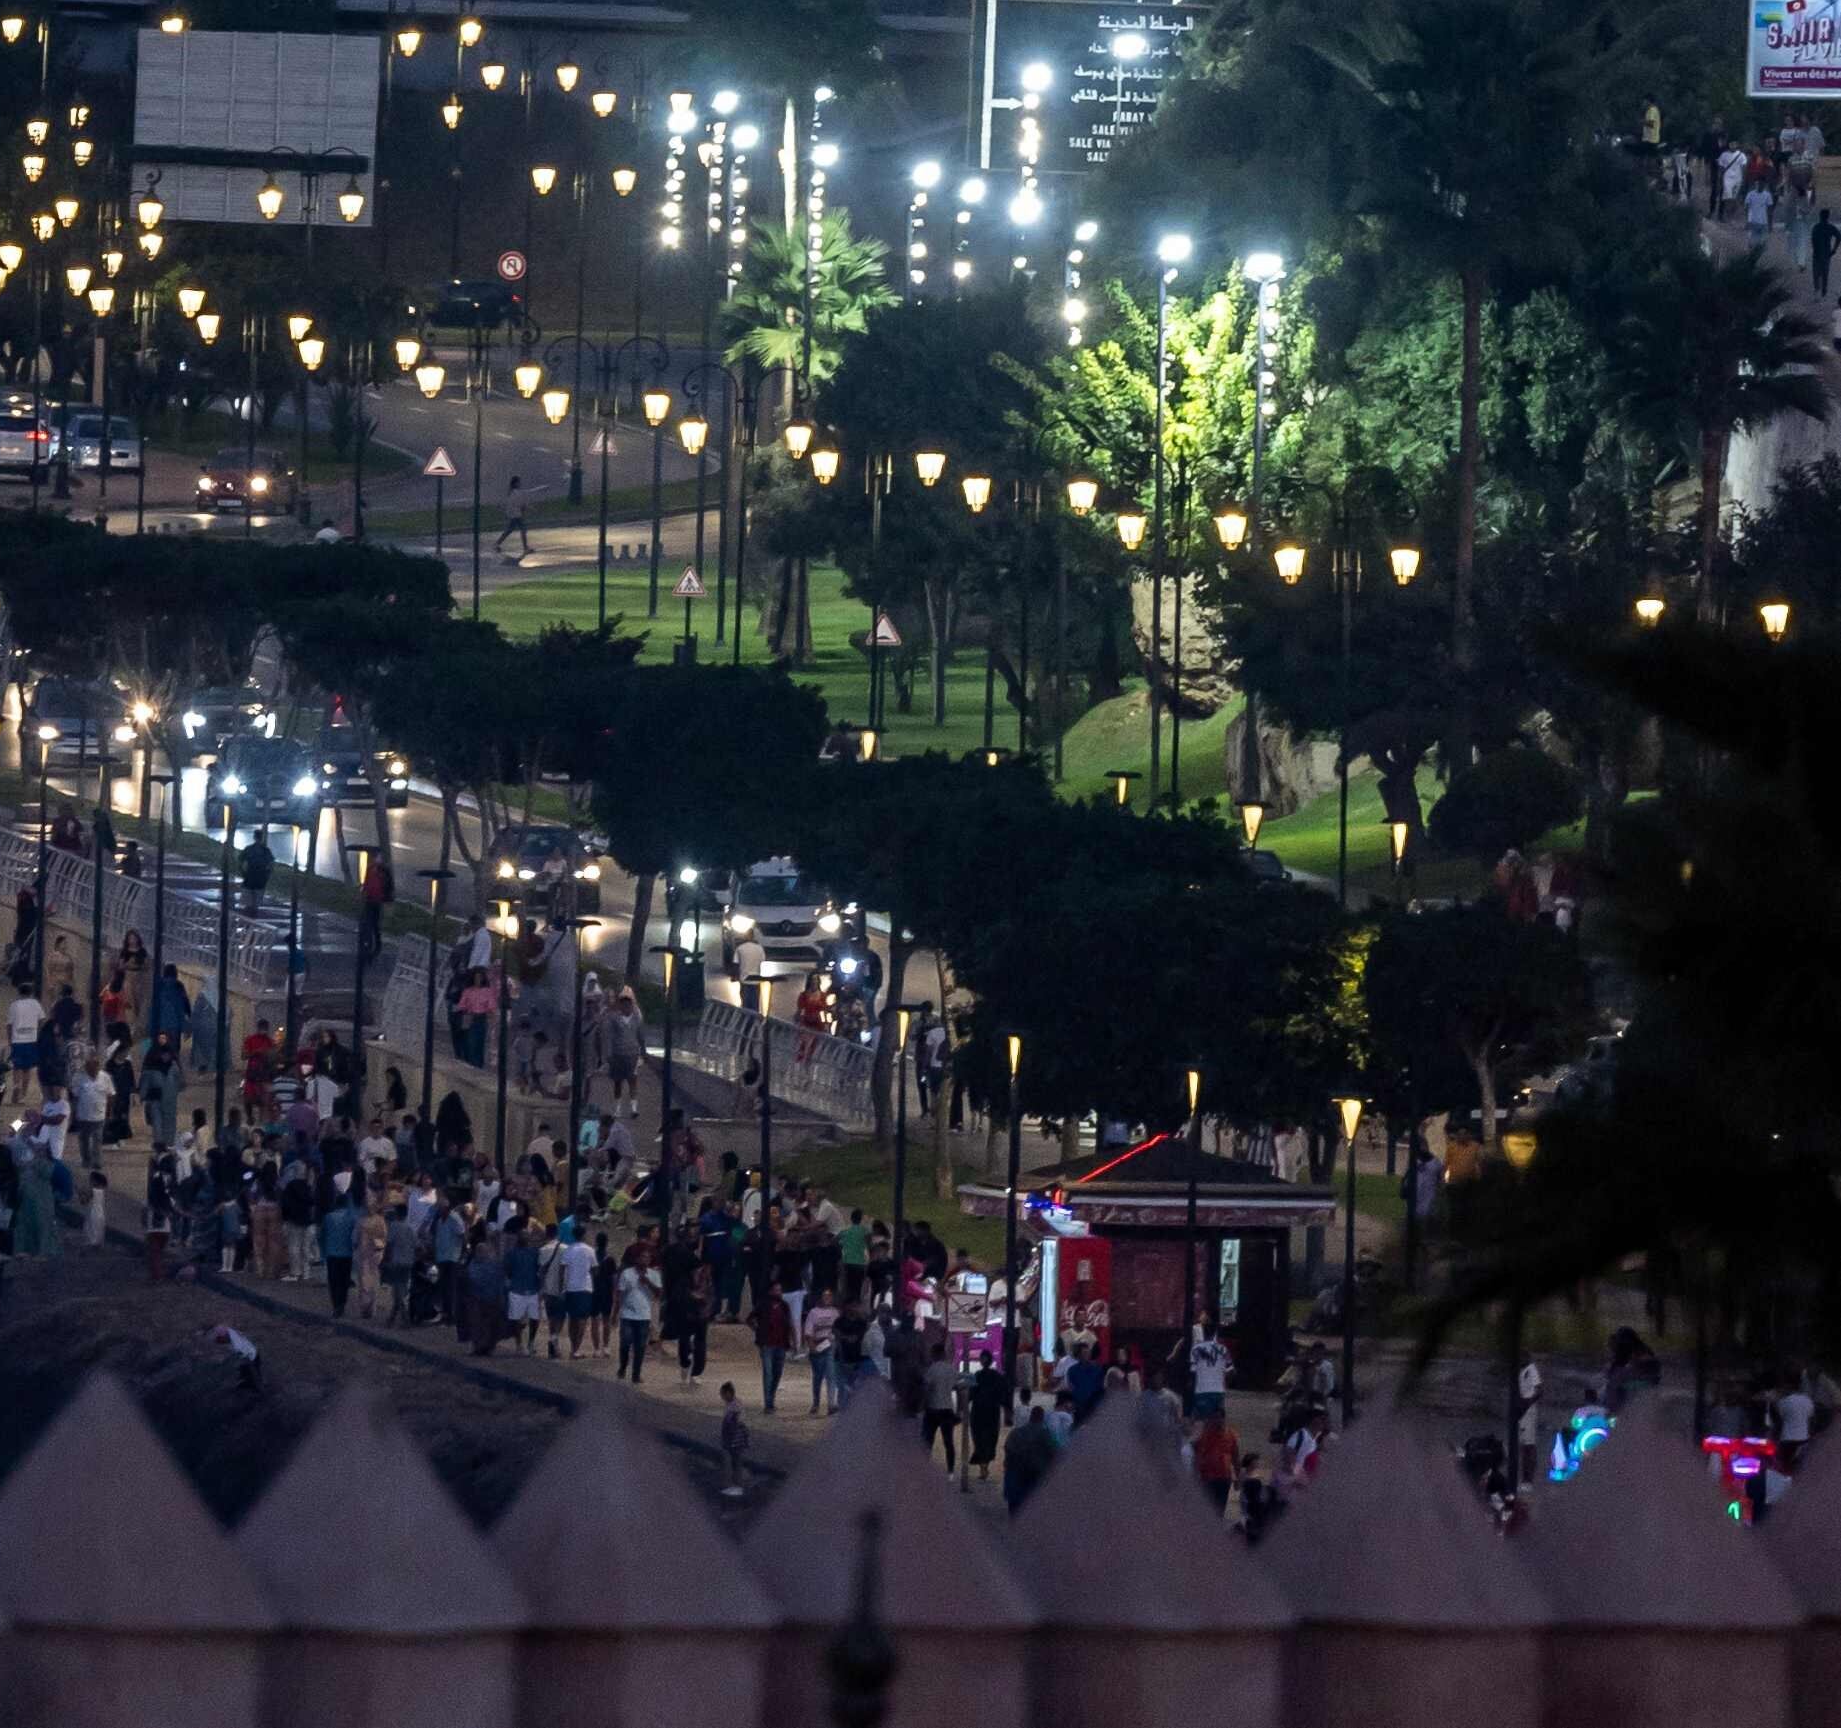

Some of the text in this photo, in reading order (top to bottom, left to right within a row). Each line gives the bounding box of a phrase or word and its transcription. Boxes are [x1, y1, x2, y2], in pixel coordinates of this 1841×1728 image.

[1098, 15, 1194, 36] الرباط المدينة
[1764, 69, 1793, 79] Vivez
[1793, 70, 1808, 79] un
[1091, 123, 1115, 136] SALE
[1069, 136, 1111, 149] SALE VIA
